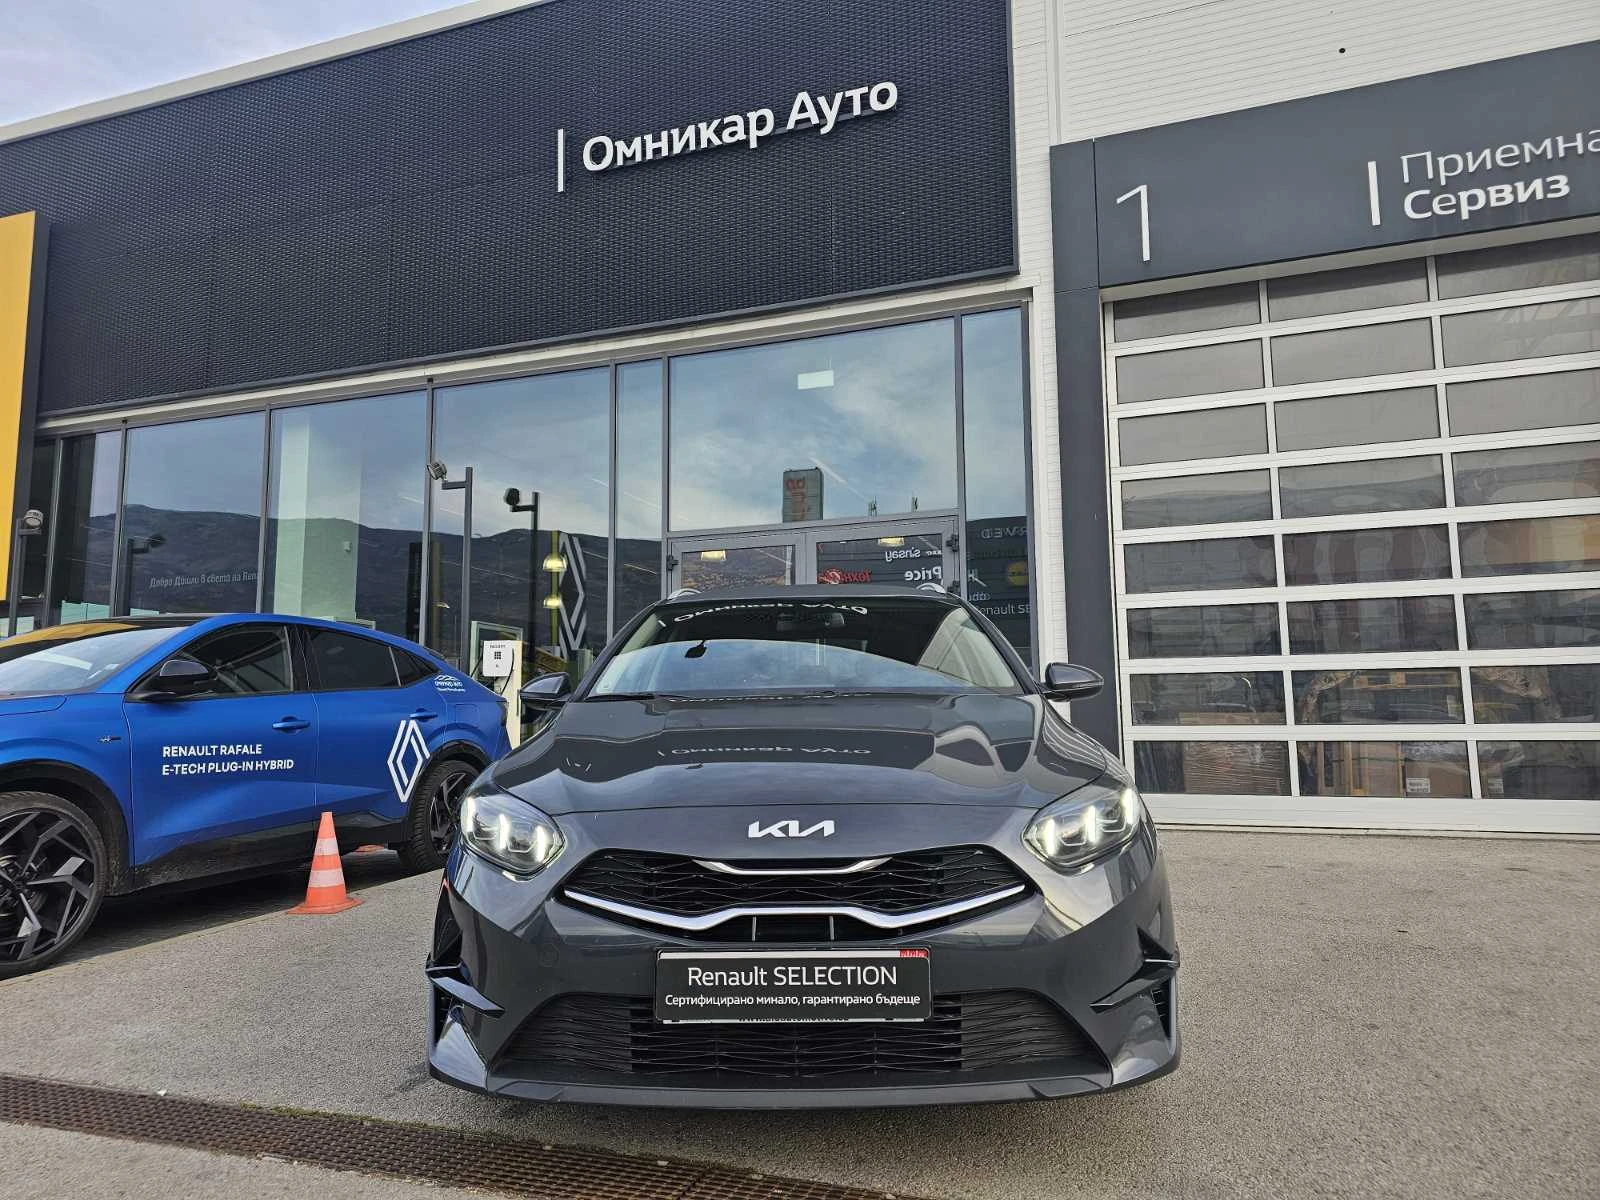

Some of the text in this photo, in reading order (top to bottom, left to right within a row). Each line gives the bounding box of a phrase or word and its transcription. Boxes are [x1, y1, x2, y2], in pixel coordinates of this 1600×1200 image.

[582, 81, 898, 172] Омникар Ауто
[1400, 129, 1600, 186] Приемна
[1403, 174, 1571, 220] Сервиз
[1115, 184, 1151, 262] 1
[977, 603, 1015, 614] enault
[162, 744, 262, 758] RENAULT RAFALE
[162, 759, 295, 776] E-TECH PLUG-IN HYBRID
[748, 820, 835, 838] KIA
[687, 965, 898, 986] Renault SELECTION
[665, 993, 921, 1008] Сертифицирано минало, гарантирано бъдеще
